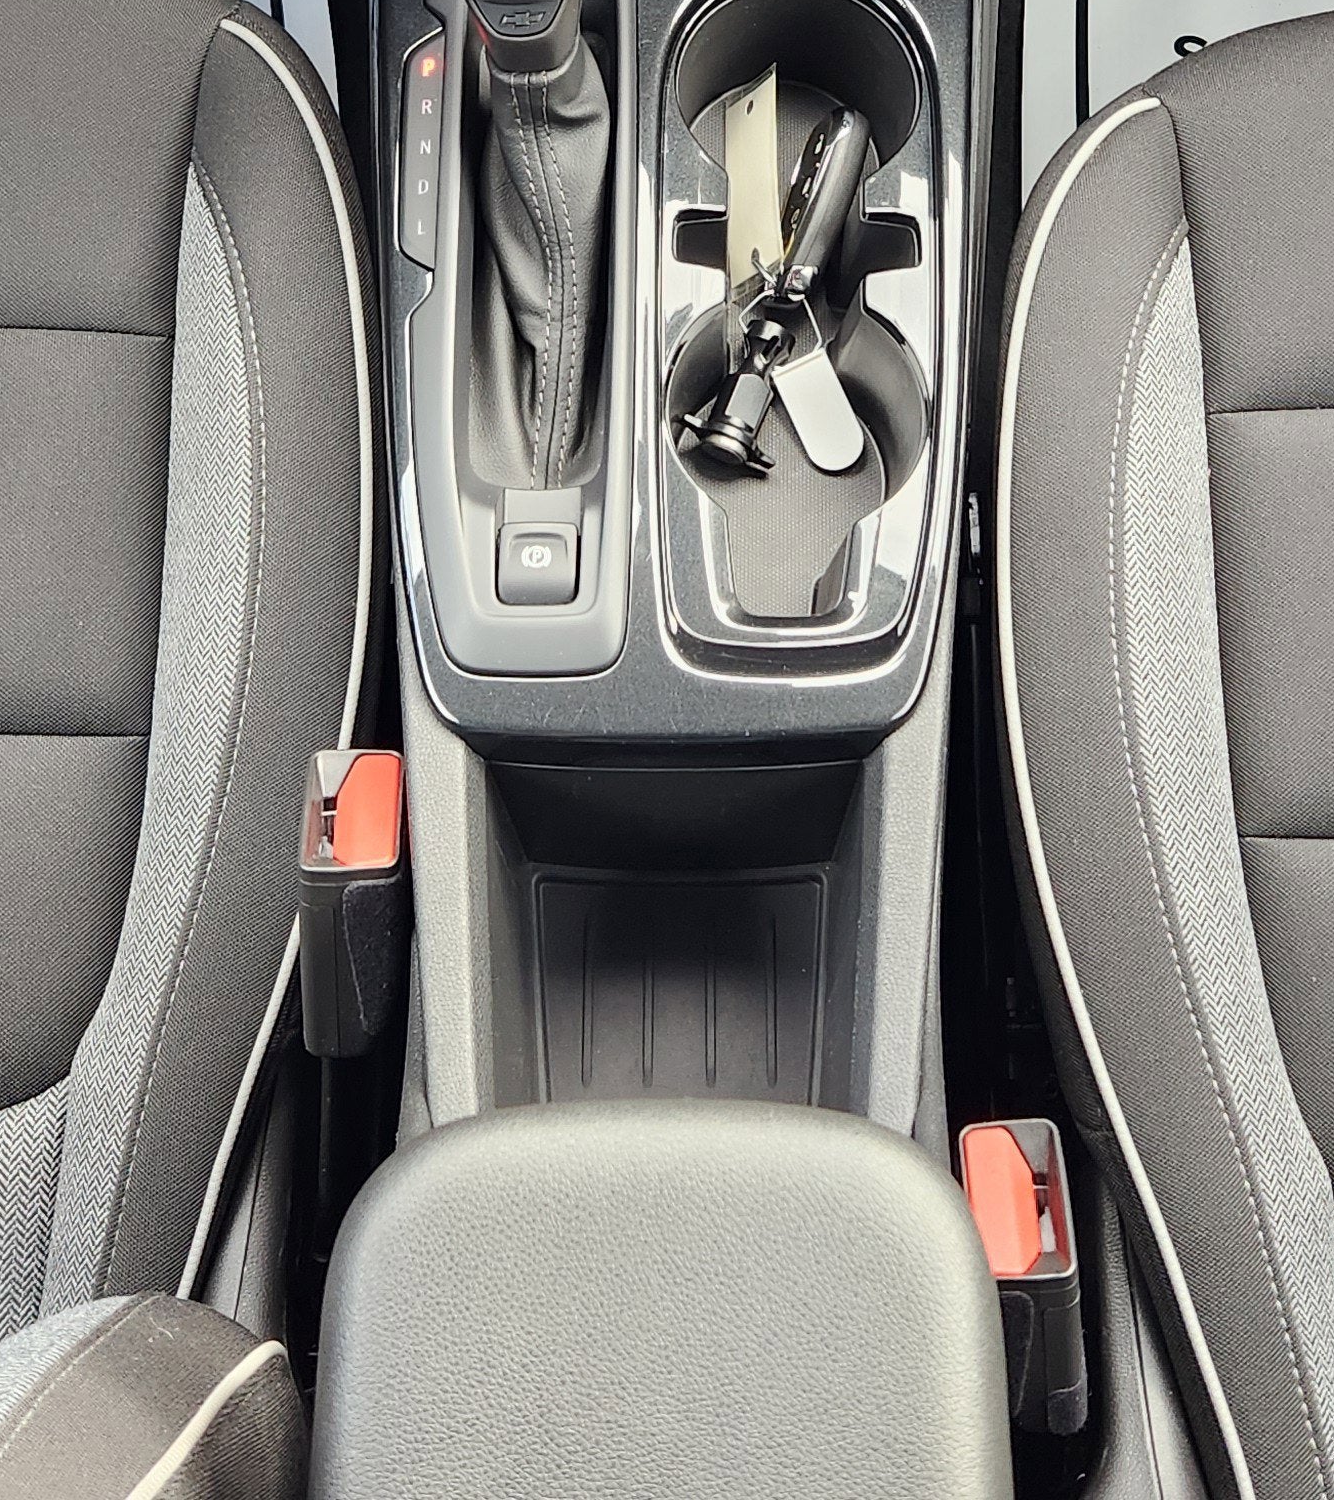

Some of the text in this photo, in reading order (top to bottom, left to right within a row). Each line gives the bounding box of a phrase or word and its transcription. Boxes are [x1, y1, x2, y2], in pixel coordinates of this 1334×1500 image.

[421, 57, 436, 77] P
[421, 99, 432, 115] R
[419, 139, 432, 155] N
[417, 179, 429, 195] D
[417, 221, 426, 235] L
